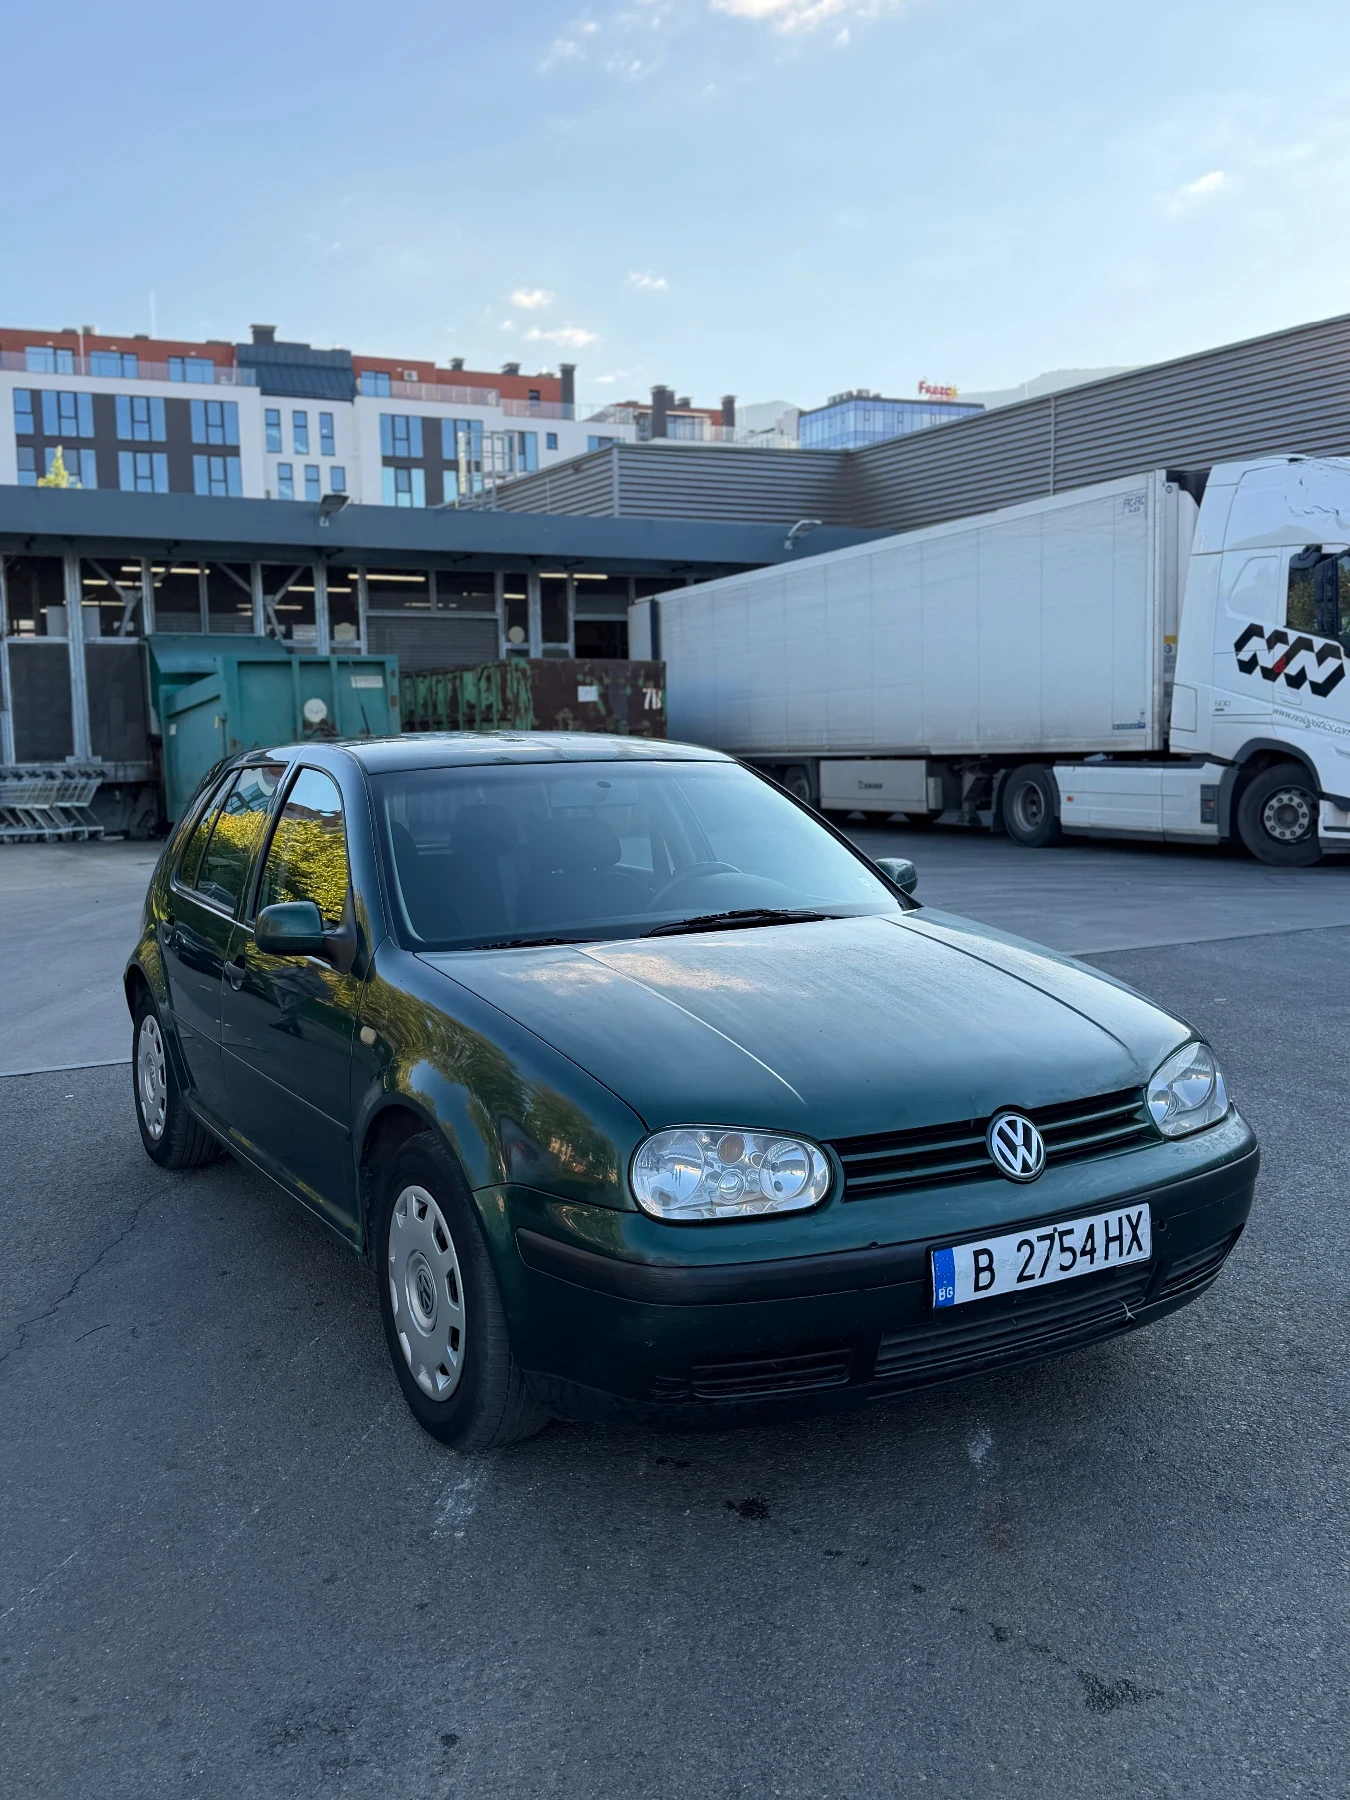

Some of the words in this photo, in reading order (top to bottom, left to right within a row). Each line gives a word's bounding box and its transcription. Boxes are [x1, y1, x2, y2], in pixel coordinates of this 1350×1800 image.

[992, 1115, 1044, 1177] VW
[973, 1247, 996, 1293] B
[1016, 1223, 1097, 1284] 2754
[1104, 1210, 1144, 1261] HX
[938, 1286, 955, 1301] BG
